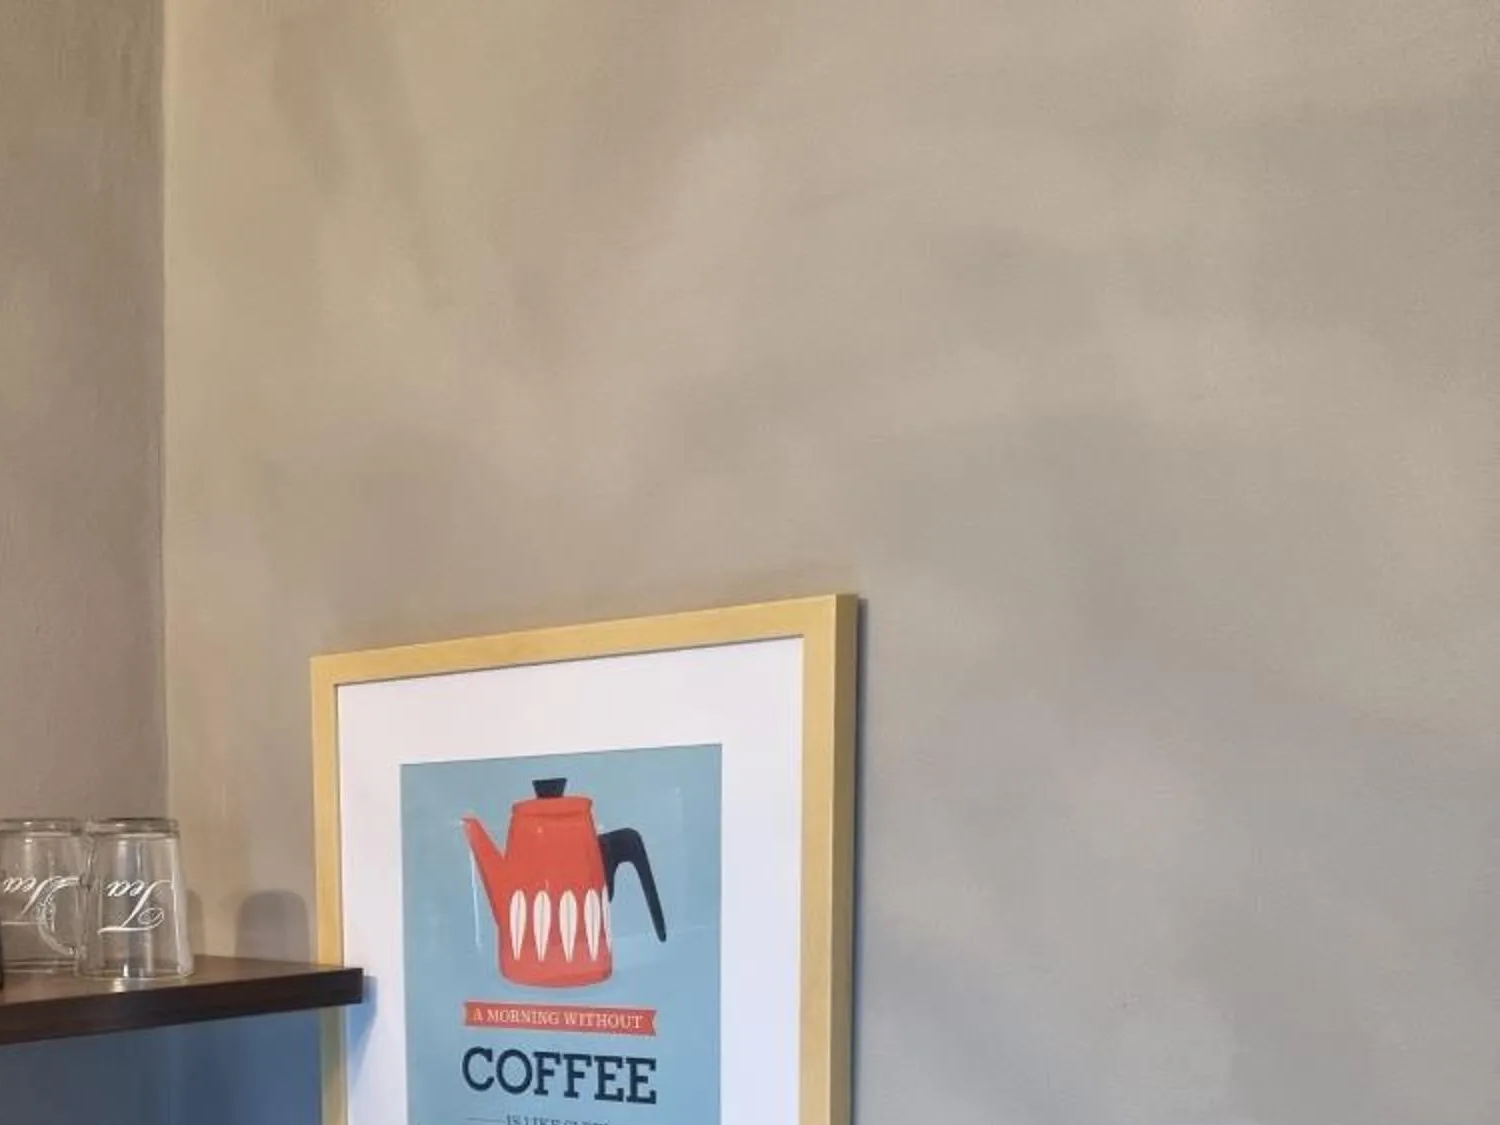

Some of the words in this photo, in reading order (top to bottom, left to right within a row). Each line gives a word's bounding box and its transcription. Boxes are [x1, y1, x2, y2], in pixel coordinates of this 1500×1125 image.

[98, 879, 173, 935] Tea
[473, 1007, 484, 1022] A
[486, 1008, 560, 1025] MORNING
[563, 1011, 644, 1029] WITHOUT
[462, 1046, 657, 1104] COFFEE
